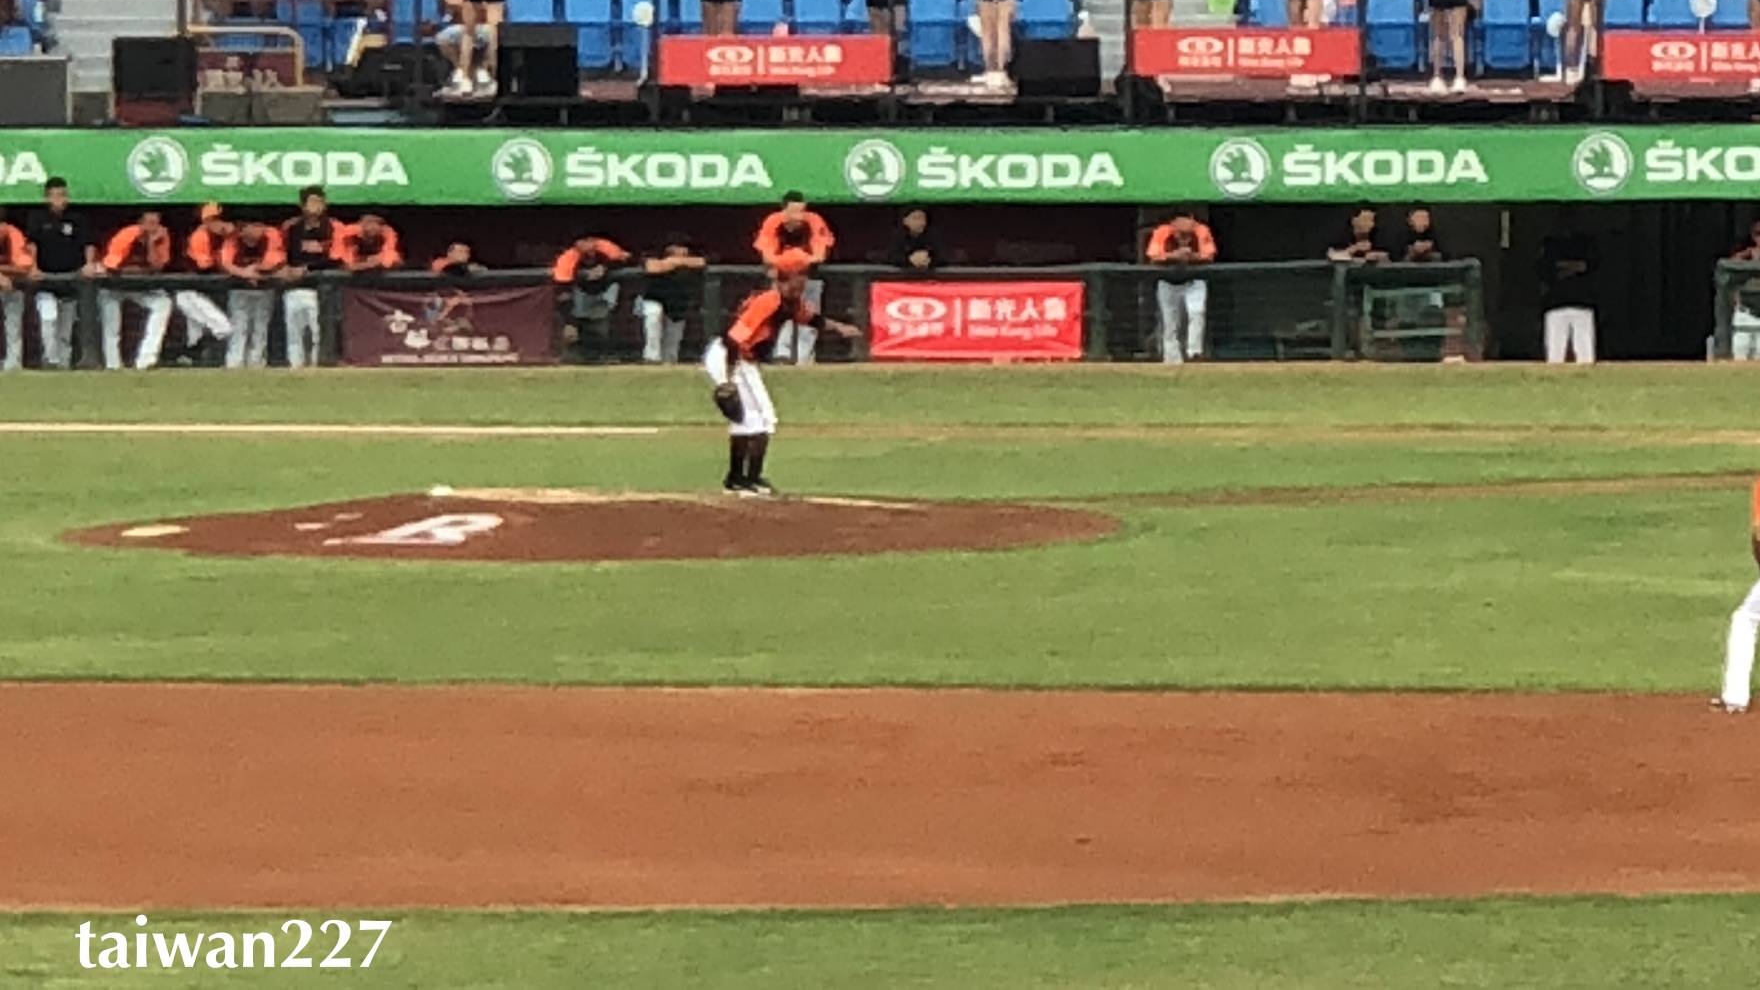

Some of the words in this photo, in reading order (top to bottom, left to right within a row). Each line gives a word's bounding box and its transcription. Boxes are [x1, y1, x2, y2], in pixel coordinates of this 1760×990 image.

[200, 144, 408, 187] ŠKODA
[565, 146, 773, 189] ŠKODA
[917, 147, 1124, 189] ŠKODA
[1282, 145, 1489, 187] ŠKODA
